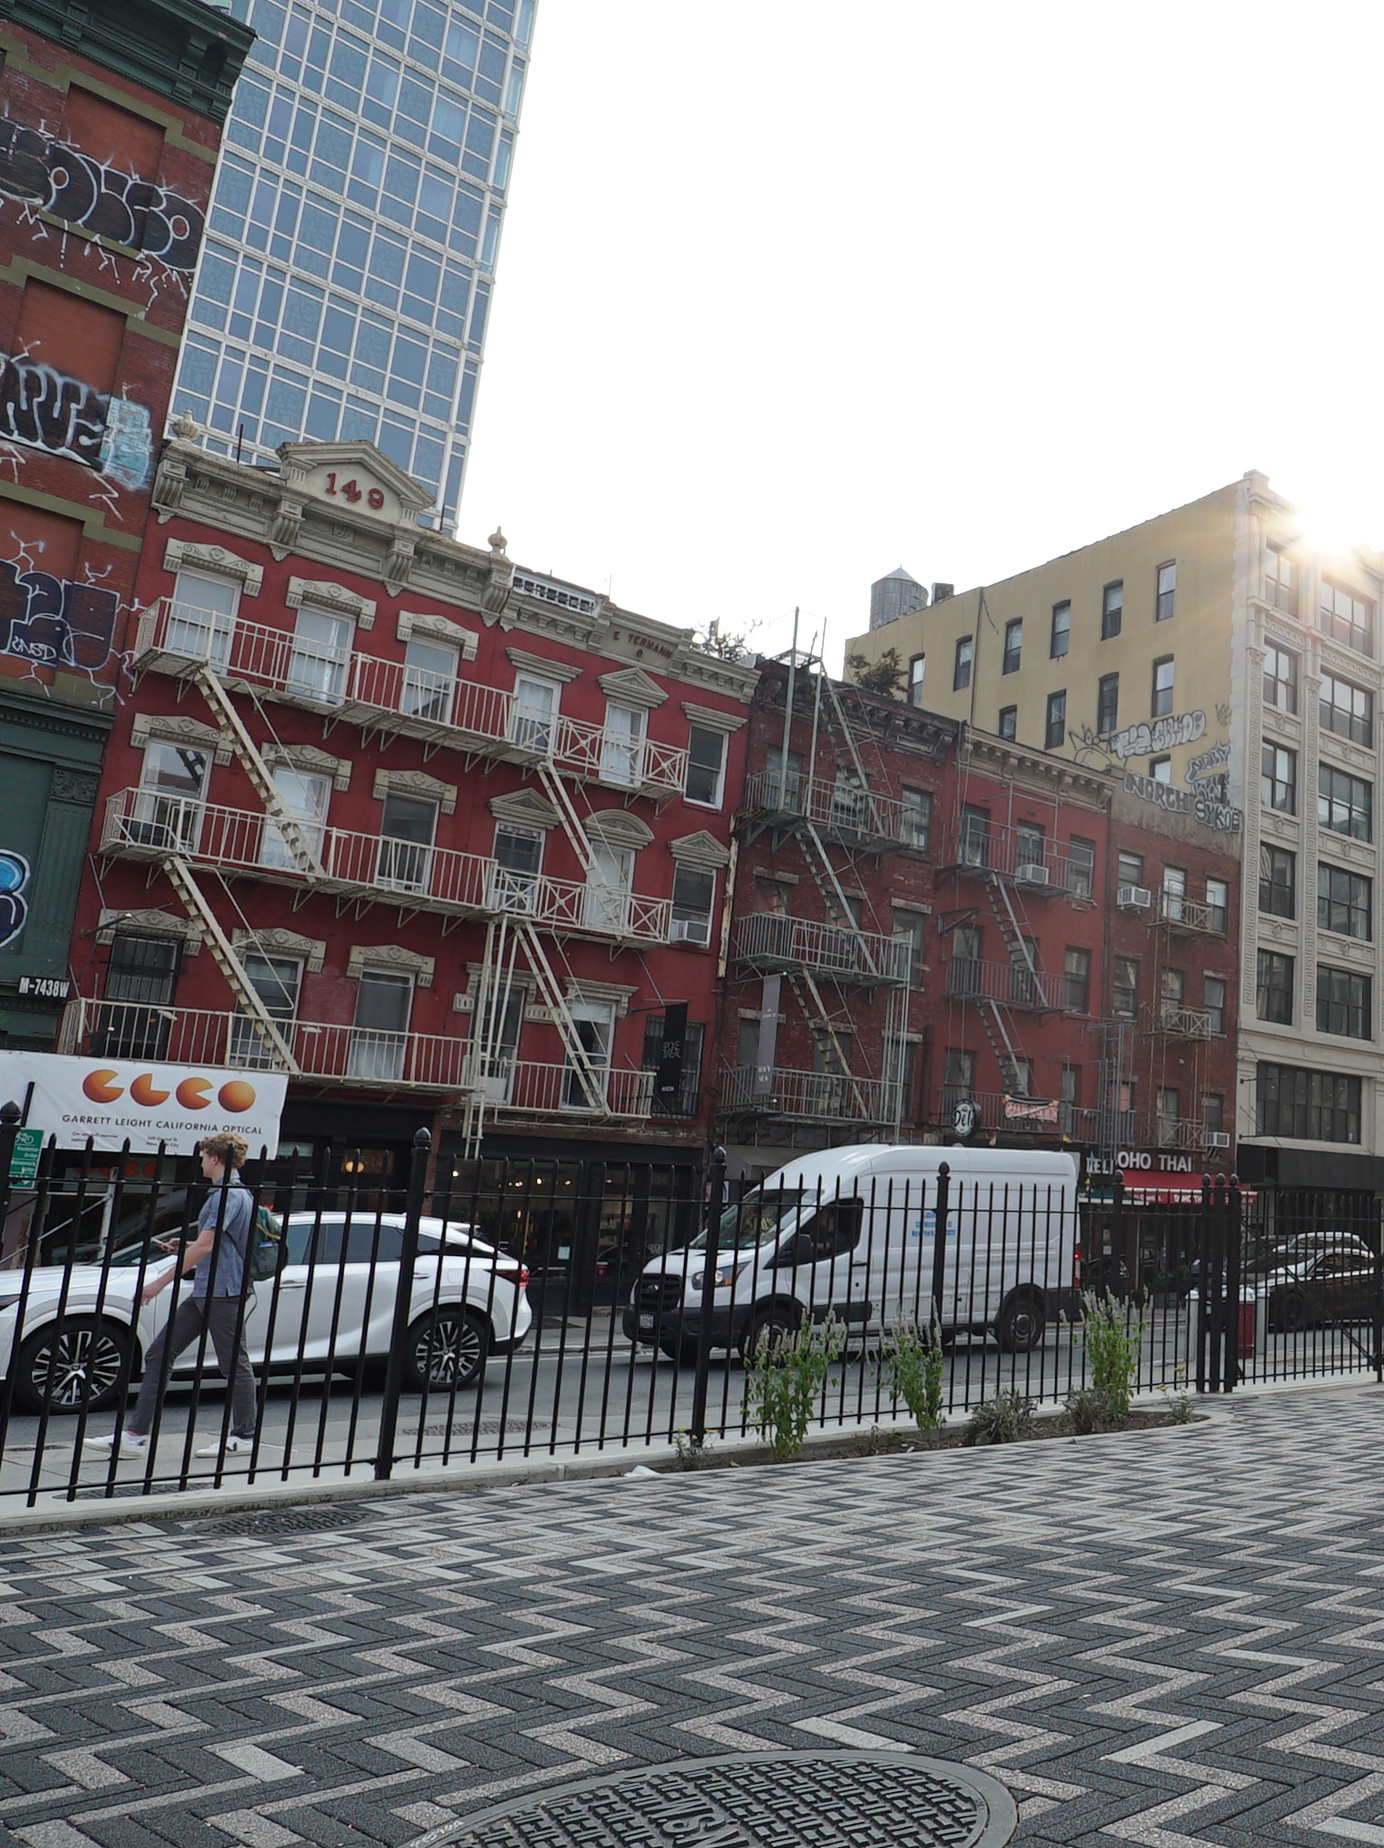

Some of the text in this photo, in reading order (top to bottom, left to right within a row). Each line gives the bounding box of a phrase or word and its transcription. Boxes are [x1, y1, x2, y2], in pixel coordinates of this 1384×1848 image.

[325, 472, 384, 510] 149
[19, 977, 70, 998] M-7438W
[62, 1114, 262, 1135] GARRETT LEIGHT CALIFORNIA OPTICAL
[1114, 1151, 1192, 1173] OHO THAI
